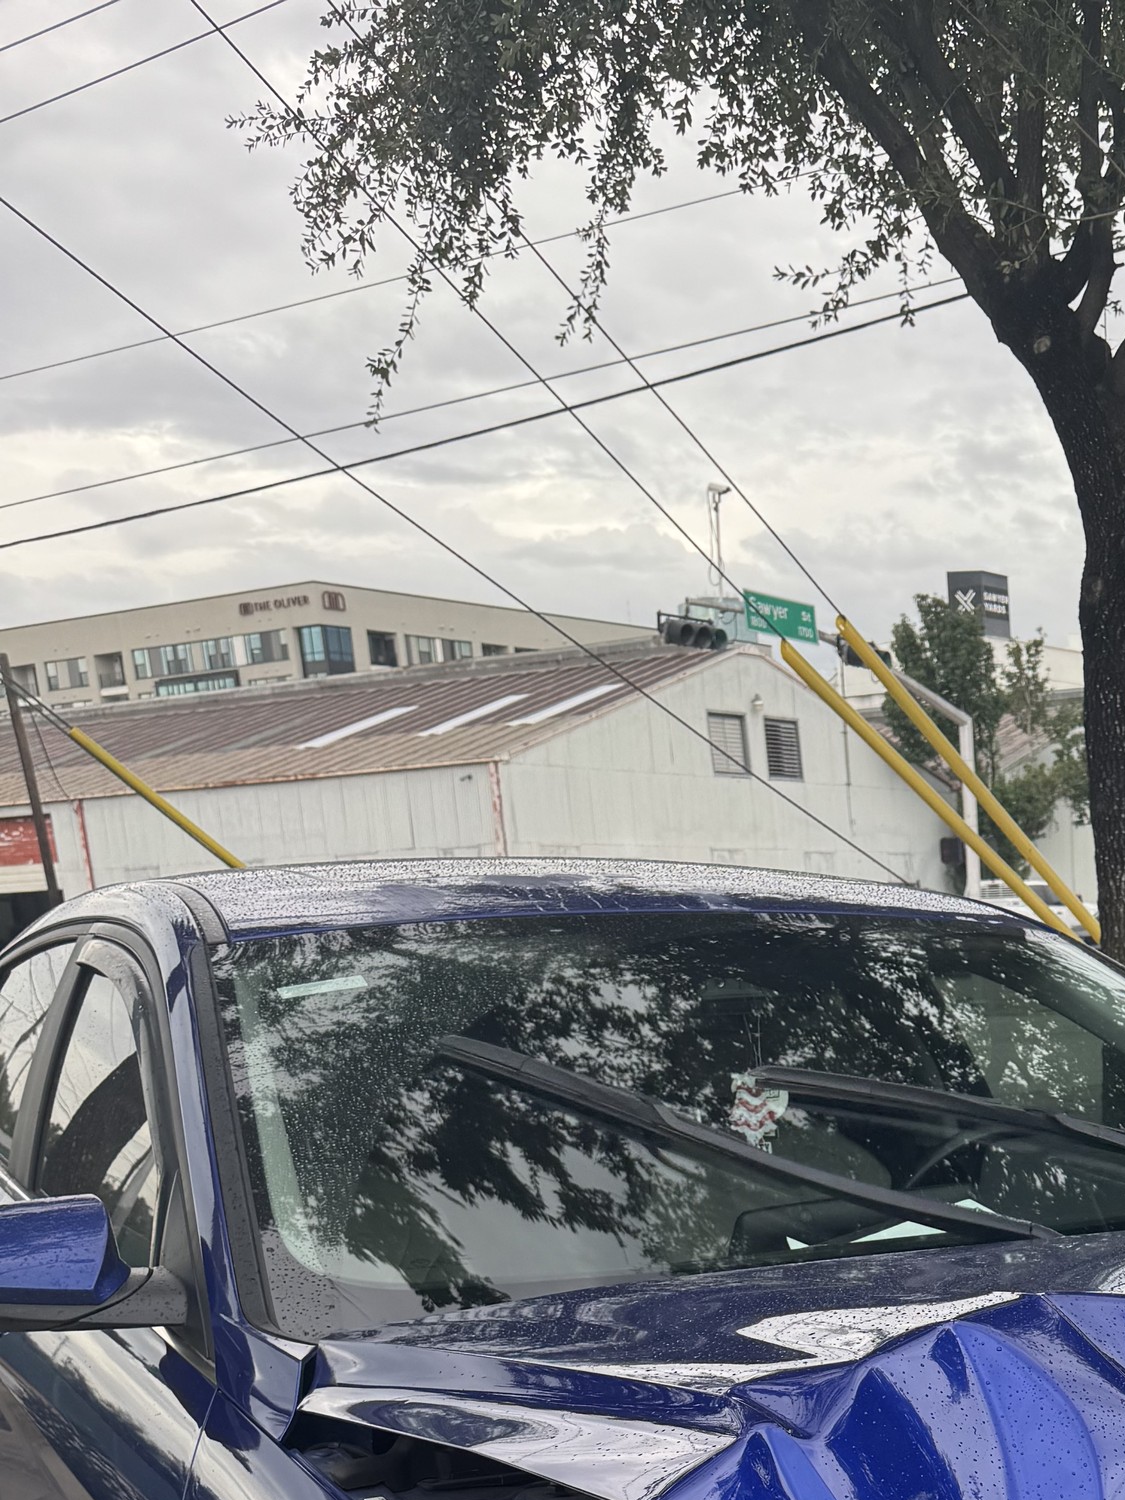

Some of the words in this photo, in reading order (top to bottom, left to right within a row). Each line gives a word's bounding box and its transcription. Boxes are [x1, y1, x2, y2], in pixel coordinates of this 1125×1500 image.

[254, 600, 272, 612] THE
[273, 595, 310, 609] OLIVER
[983, 592, 1008, 604] SAWYER
[749, 596, 788, 621] Sawyer
[801, 611, 812, 623] St
[984, 602, 1007, 614] YARDS
